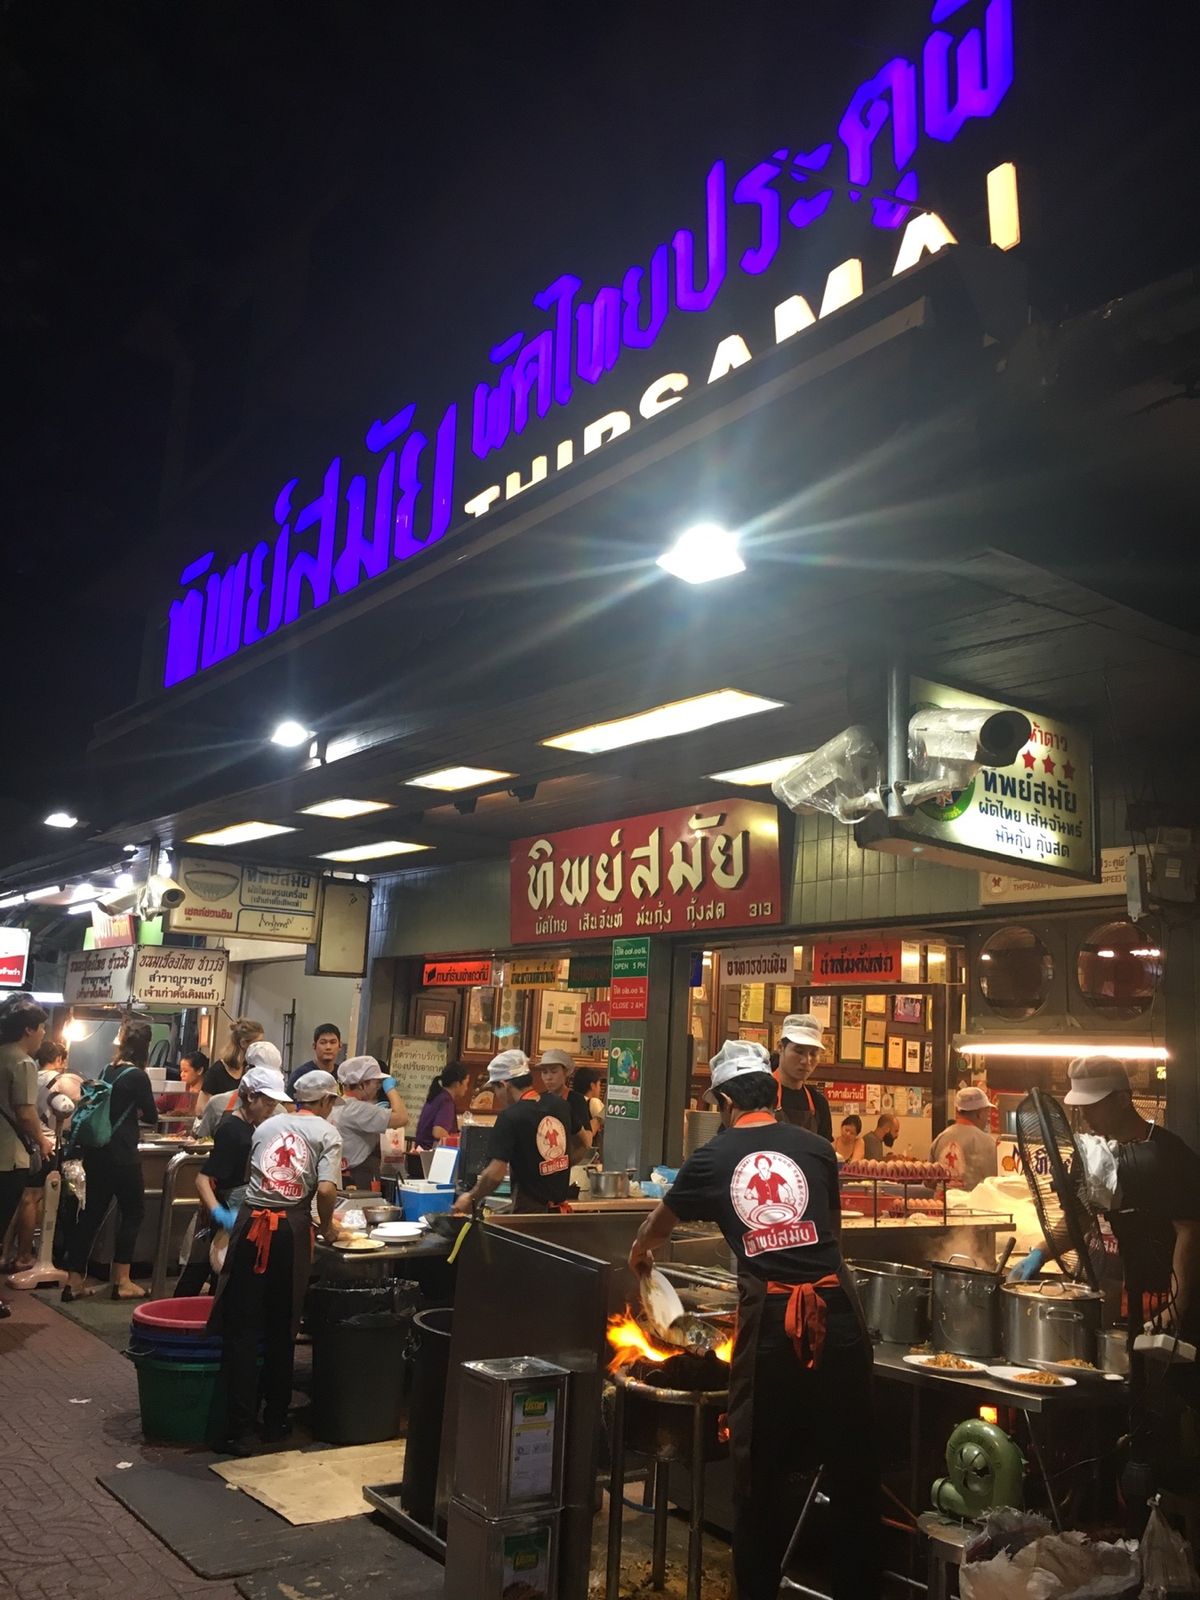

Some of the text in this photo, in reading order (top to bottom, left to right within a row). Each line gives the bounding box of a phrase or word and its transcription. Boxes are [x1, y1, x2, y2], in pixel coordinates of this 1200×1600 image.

[163, 402, 458, 689] ทิพย์สมัย
[978, 797, 1022, 823] ผัดไทย
[527, 813, 748, 910] ทิพย์สมัย
[614, 962, 629, 970] OPEN
[584, 1004, 611, 1028] สั่งก
[611, 1001, 629, 1010] CLOSE
[588, 1035, 606, 1048] Take
[746, 1225, 811, 1254] ทิพย์สมัย
